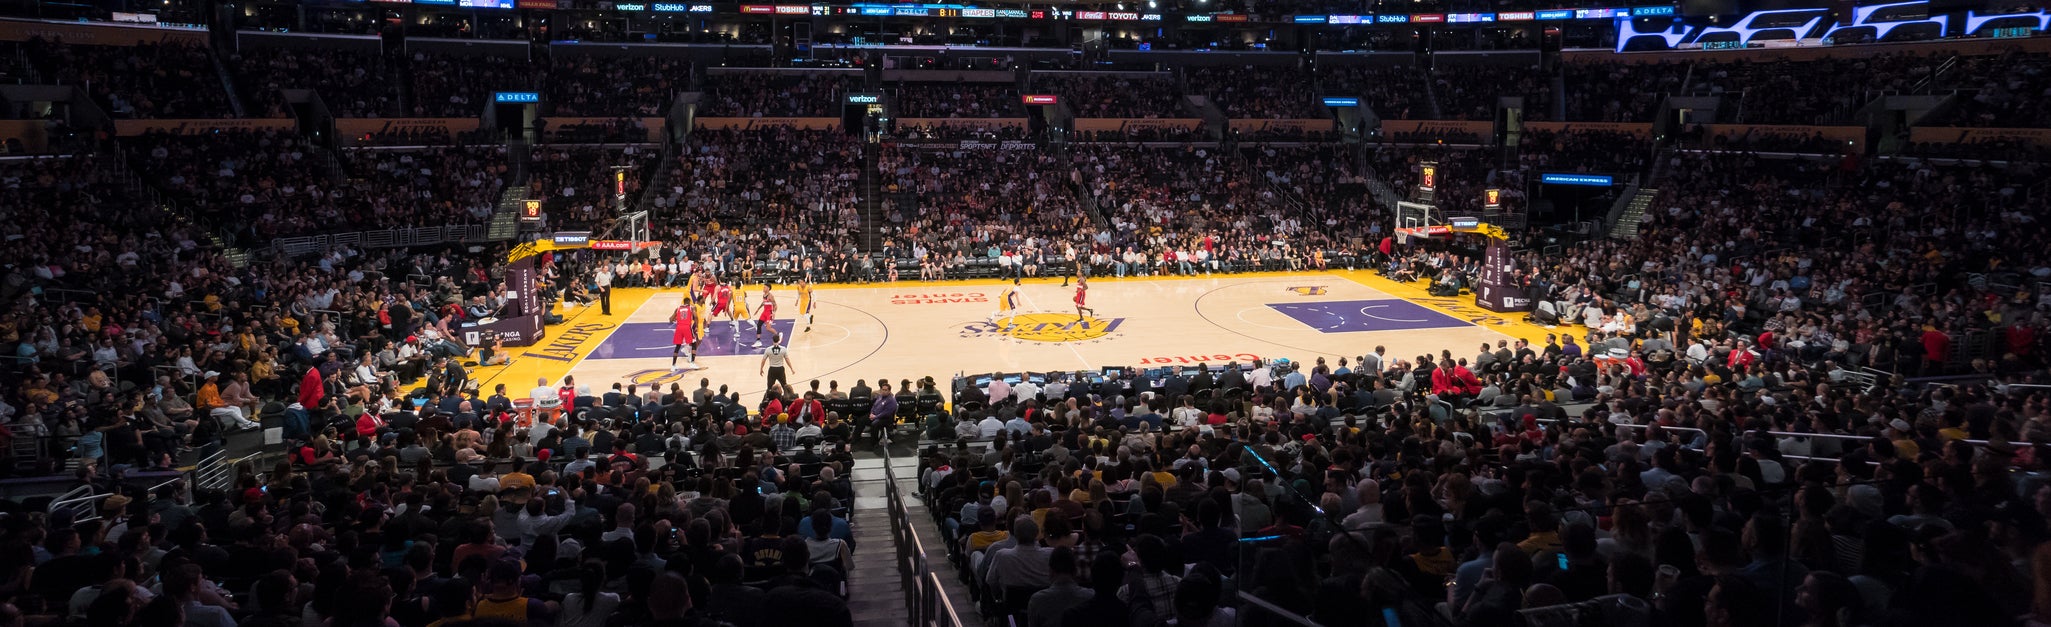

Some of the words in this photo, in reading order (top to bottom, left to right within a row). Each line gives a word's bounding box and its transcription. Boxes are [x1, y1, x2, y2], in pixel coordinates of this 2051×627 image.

[617, 3, 644, 11] verizon
[940, 9, 956, 17] 8:11
[963, 9, 993, 17] STAPLES
[849, 95, 877, 103] verizon
[519, 321, 617, 364] LAKERS
[1140, 353, 1260, 364] Center
